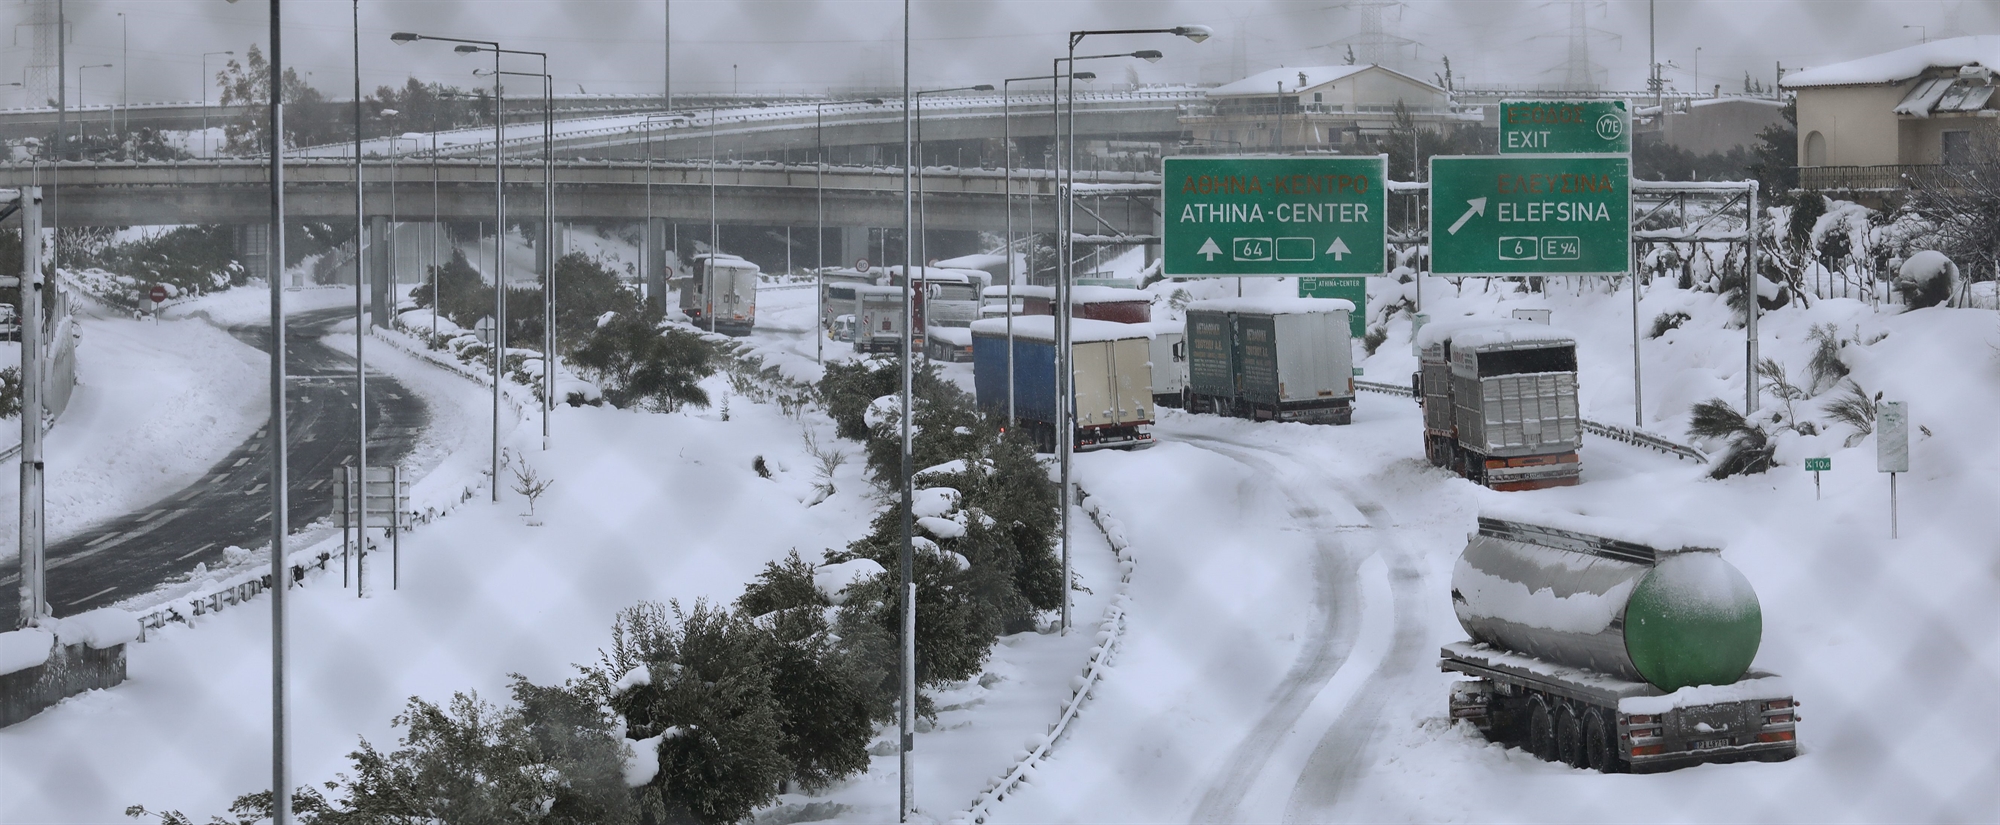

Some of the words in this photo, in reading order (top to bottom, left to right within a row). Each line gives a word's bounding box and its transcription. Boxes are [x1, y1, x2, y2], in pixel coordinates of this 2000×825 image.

[1507, 106, 1584, 124] ΕΞΟΔΟΣ
[1508, 131, 1550, 148] EXIT
[1498, 174, 1613, 194] ΕΛΕΥΣΙΝΑ
[1499, 202, 1611, 222] ELEFSINA
[1243, 242, 1263, 256] 64
[1514, 241, 1524, 255] 6
